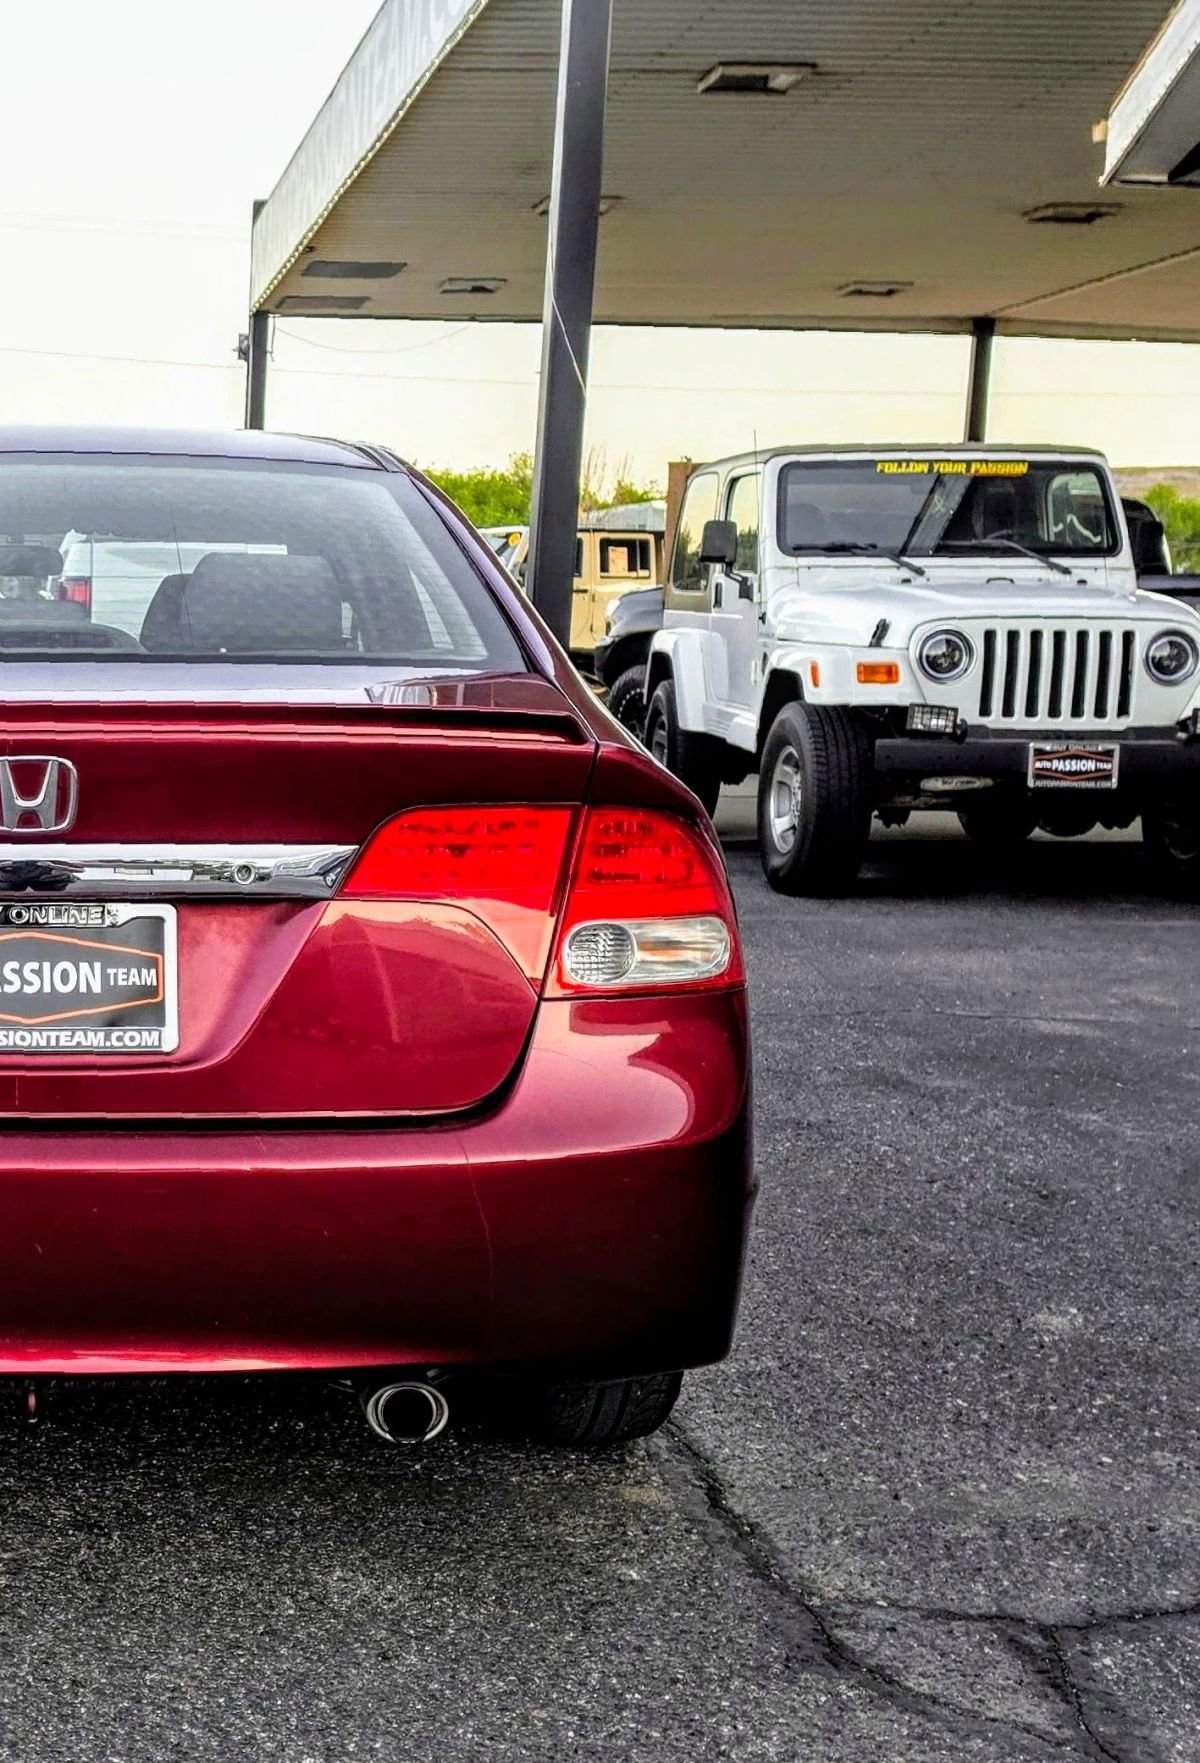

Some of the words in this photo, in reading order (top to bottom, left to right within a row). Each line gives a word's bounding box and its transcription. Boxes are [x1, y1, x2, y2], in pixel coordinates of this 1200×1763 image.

[876, 461, 929, 474] FOLLOW
[932, 461, 966, 474] YOUR
[970, 461, 1029, 475] PASSION
[1052, 759, 1096, 772] PASSION
[9, 905, 104, 925] ONLINE
[107, 967, 158, 987] TEAM
